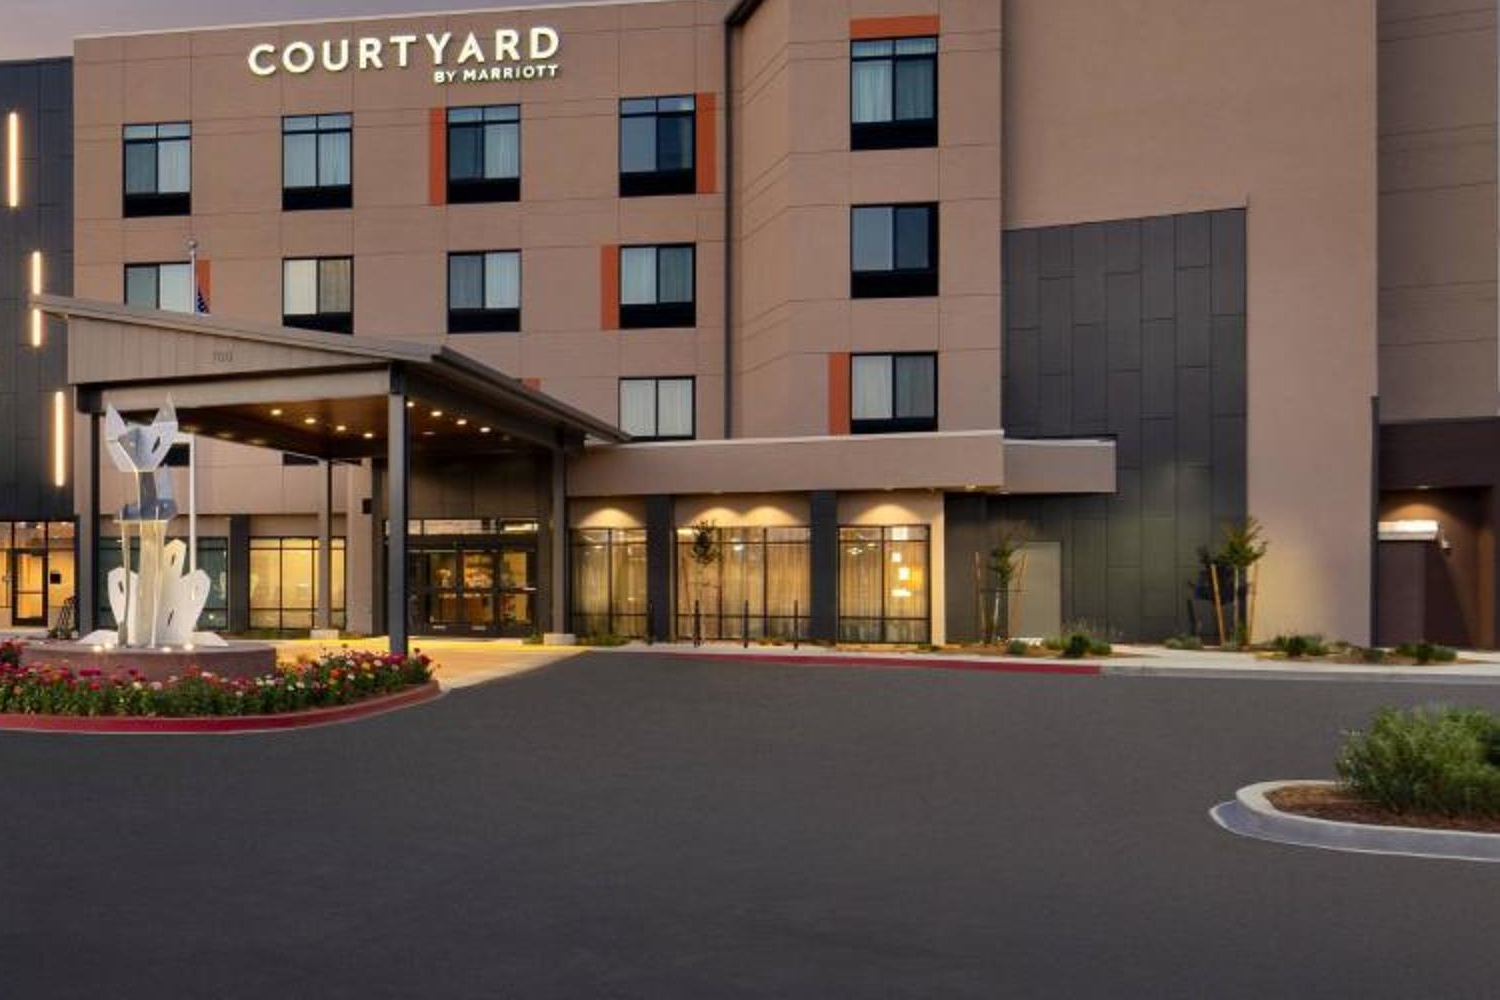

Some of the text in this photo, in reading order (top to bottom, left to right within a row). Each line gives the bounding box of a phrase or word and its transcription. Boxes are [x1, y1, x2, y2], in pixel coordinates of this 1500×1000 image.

[248, 26, 559, 75] COURTYARD
[434, 64, 558, 83] BY MARRIOTT
